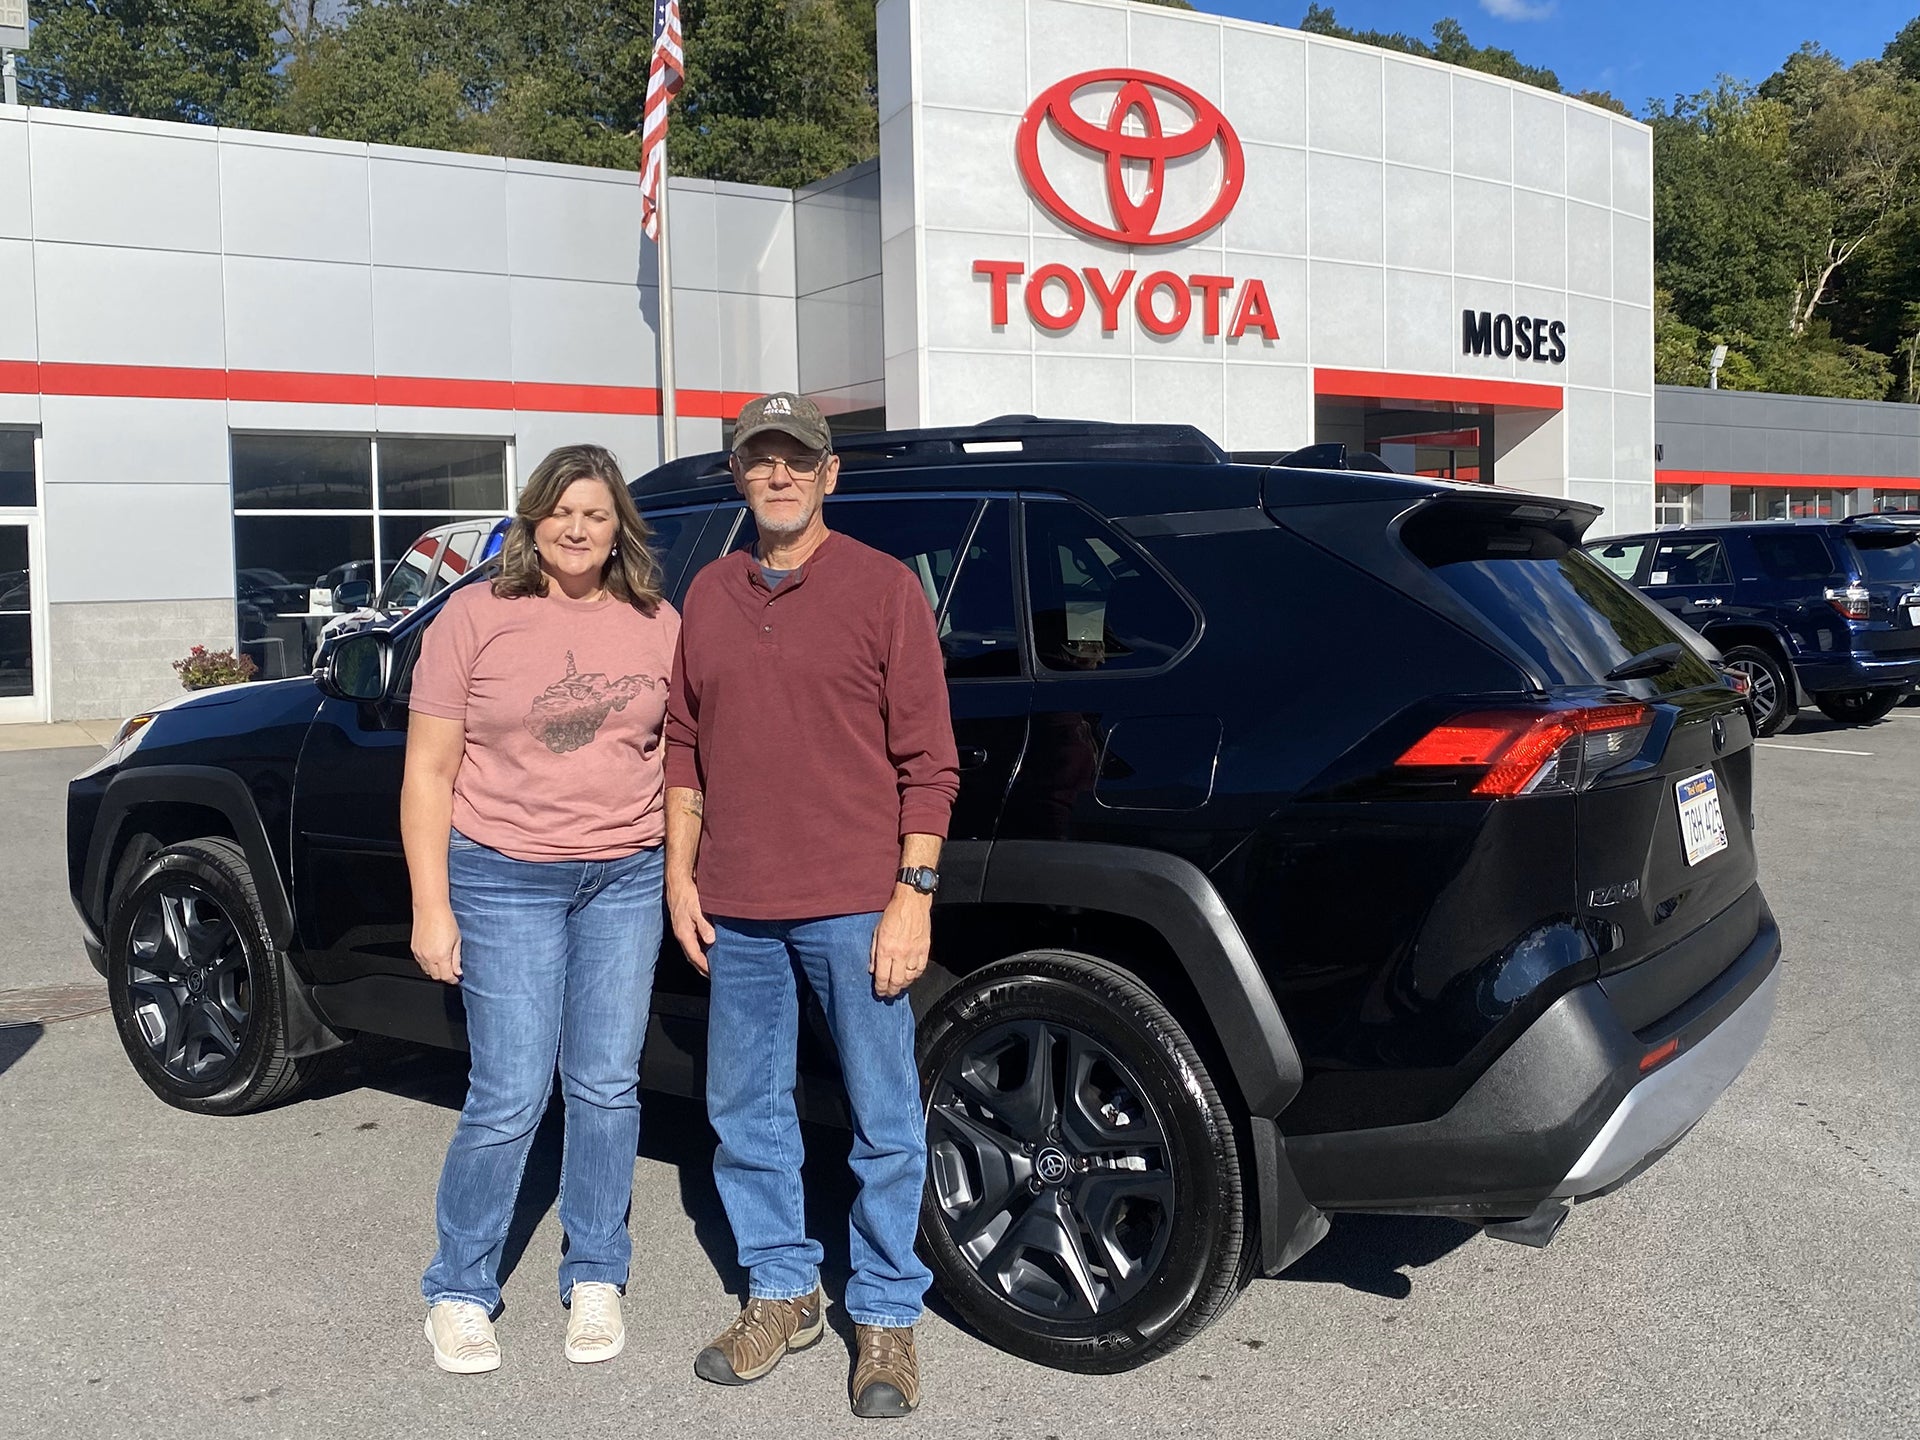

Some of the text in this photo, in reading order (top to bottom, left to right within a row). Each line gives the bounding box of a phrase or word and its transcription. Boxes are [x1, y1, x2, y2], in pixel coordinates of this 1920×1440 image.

[972, 259, 1280, 341] TOYOTA
[1462, 309, 1566, 364] MOSES
[1685, 806, 1705, 846] 78H
[1704, 798, 1722, 835] 425
